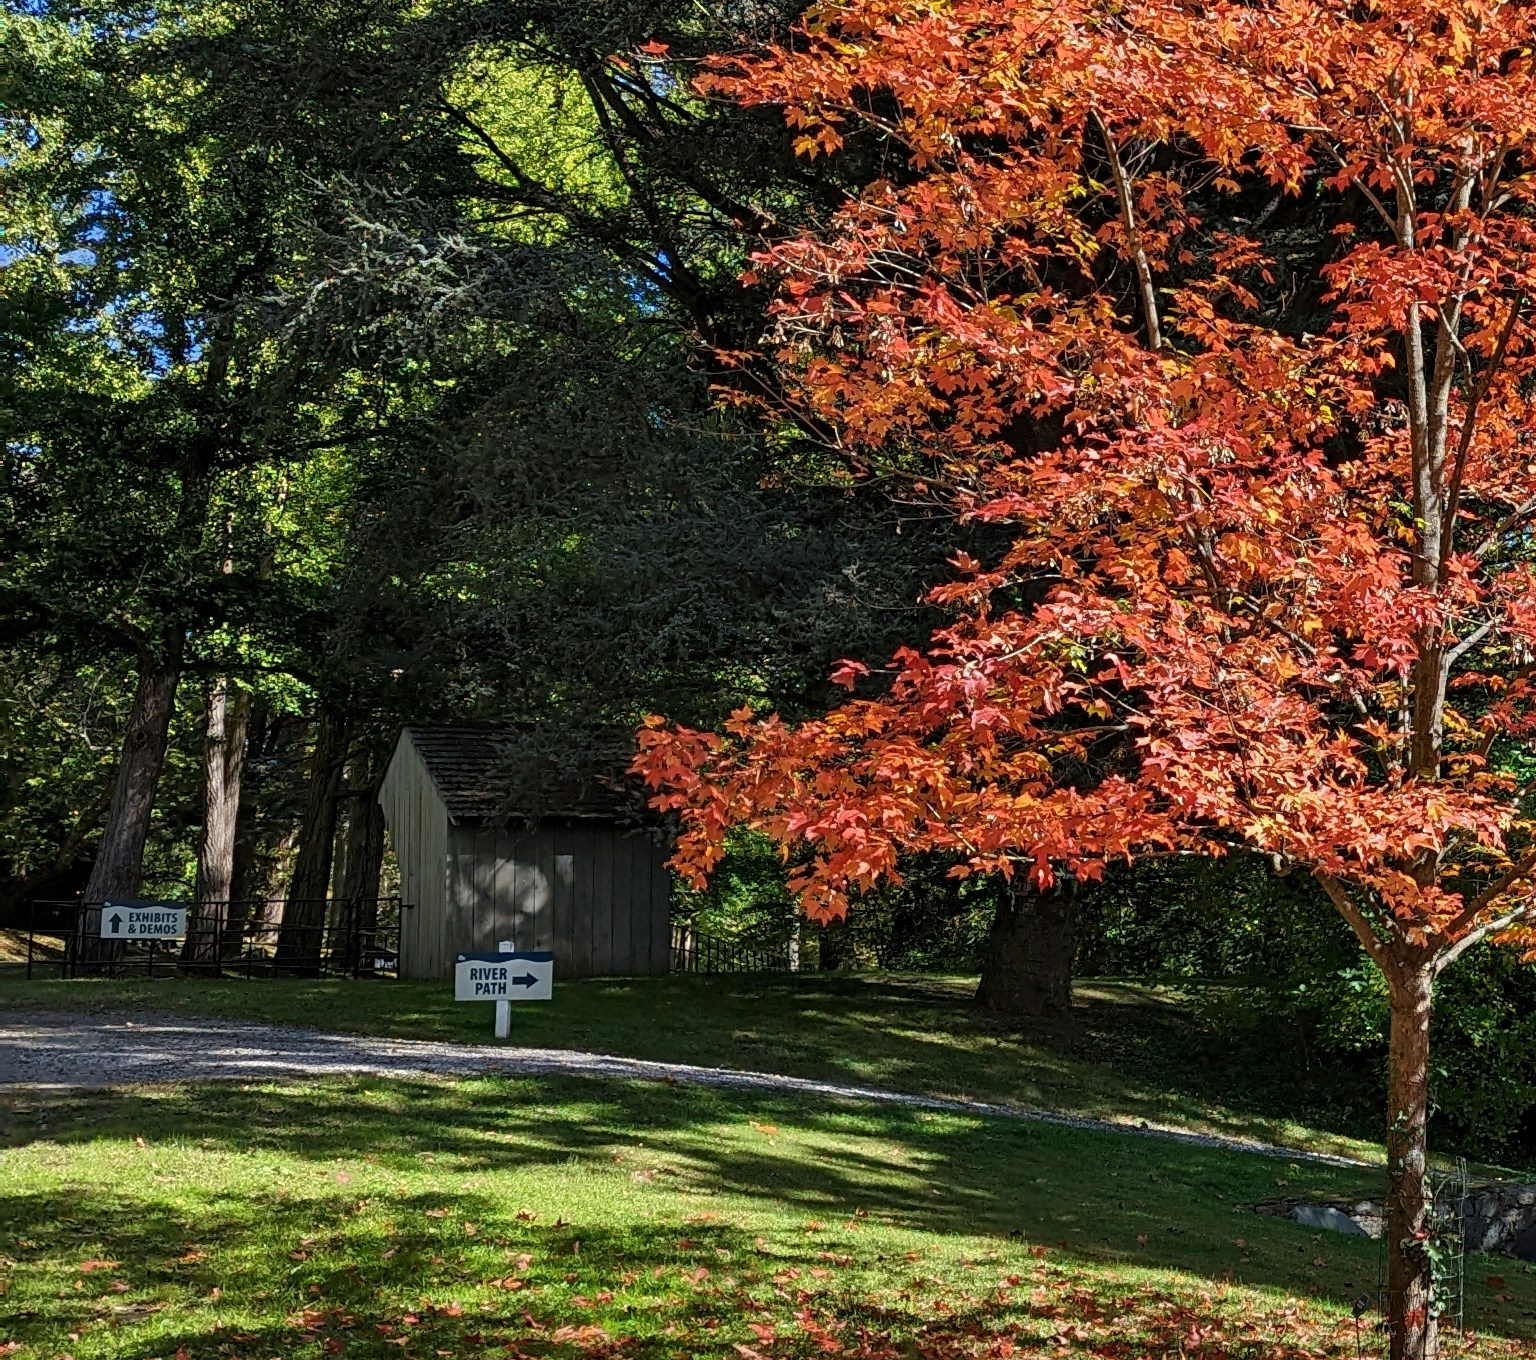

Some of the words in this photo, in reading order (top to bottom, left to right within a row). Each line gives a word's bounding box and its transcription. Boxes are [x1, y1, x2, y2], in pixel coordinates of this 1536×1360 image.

[129, 912, 178, 923] EXHIBITS
[128, 924, 136, 934] &
[139, 924, 177, 934] DEMOS
[470, 968, 507, 980] RIVER
[475, 982, 506, 995] PATH
